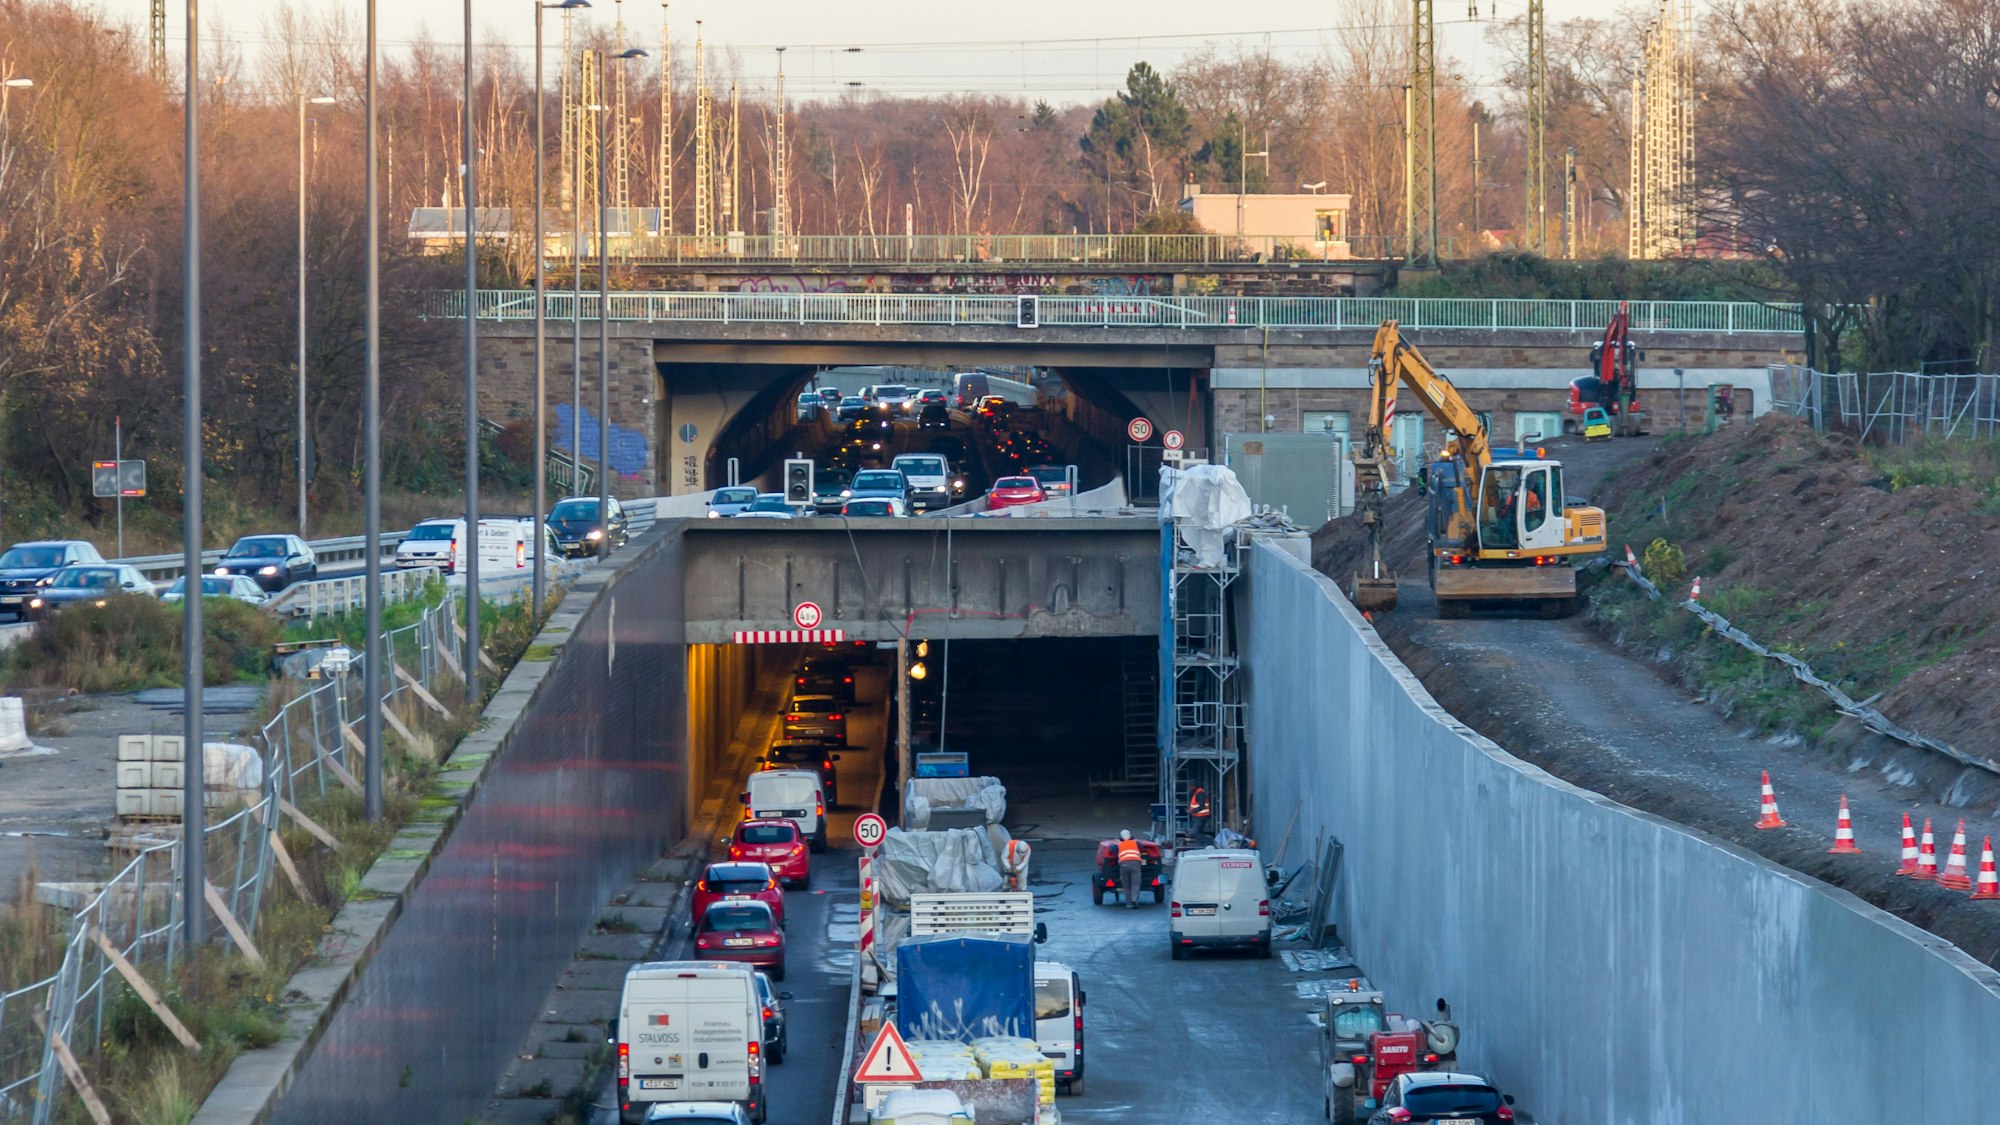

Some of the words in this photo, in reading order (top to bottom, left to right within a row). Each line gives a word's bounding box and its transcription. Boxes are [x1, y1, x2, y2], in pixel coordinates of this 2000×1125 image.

[1133, 423, 1147, 434] 50
[861, 823, 879, 838] 50
[638, 1033, 680, 1043] STALVOSS
